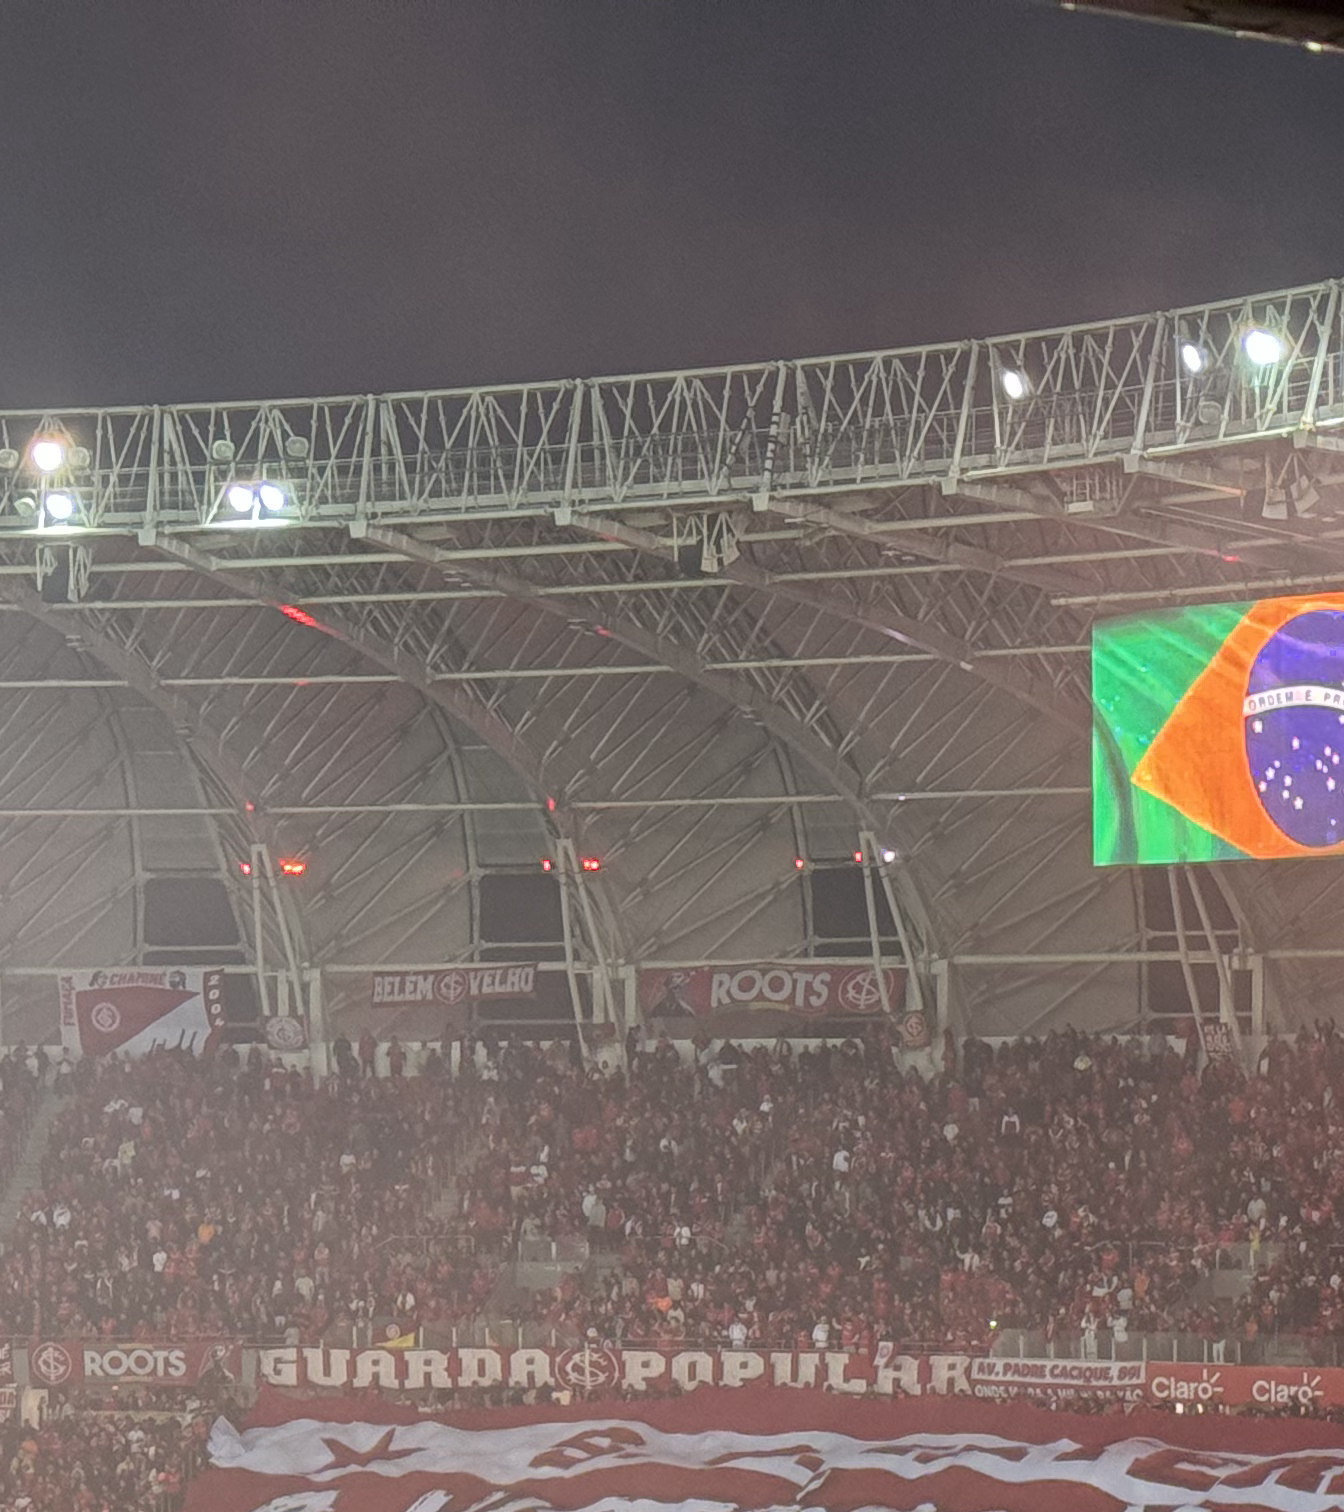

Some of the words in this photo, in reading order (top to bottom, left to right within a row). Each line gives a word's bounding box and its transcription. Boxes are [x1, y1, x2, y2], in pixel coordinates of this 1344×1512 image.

[1248, 689, 1294, 711] ORDEM
[1304, 688, 1313, 702] E
[469, 966, 535, 996] VELHO
[710, 969, 831, 1008] ROOTS
[83, 1348, 187, 1378] ROOTS
[260, 1346, 552, 1390] GUARDA
[622, 1349, 974, 1396] POPULAR
[1002, 1363, 1047, 1379] PADRE
[1151, 1373, 1214, 1401] Claro
[1252, 1377, 1311, 1404] Claro
